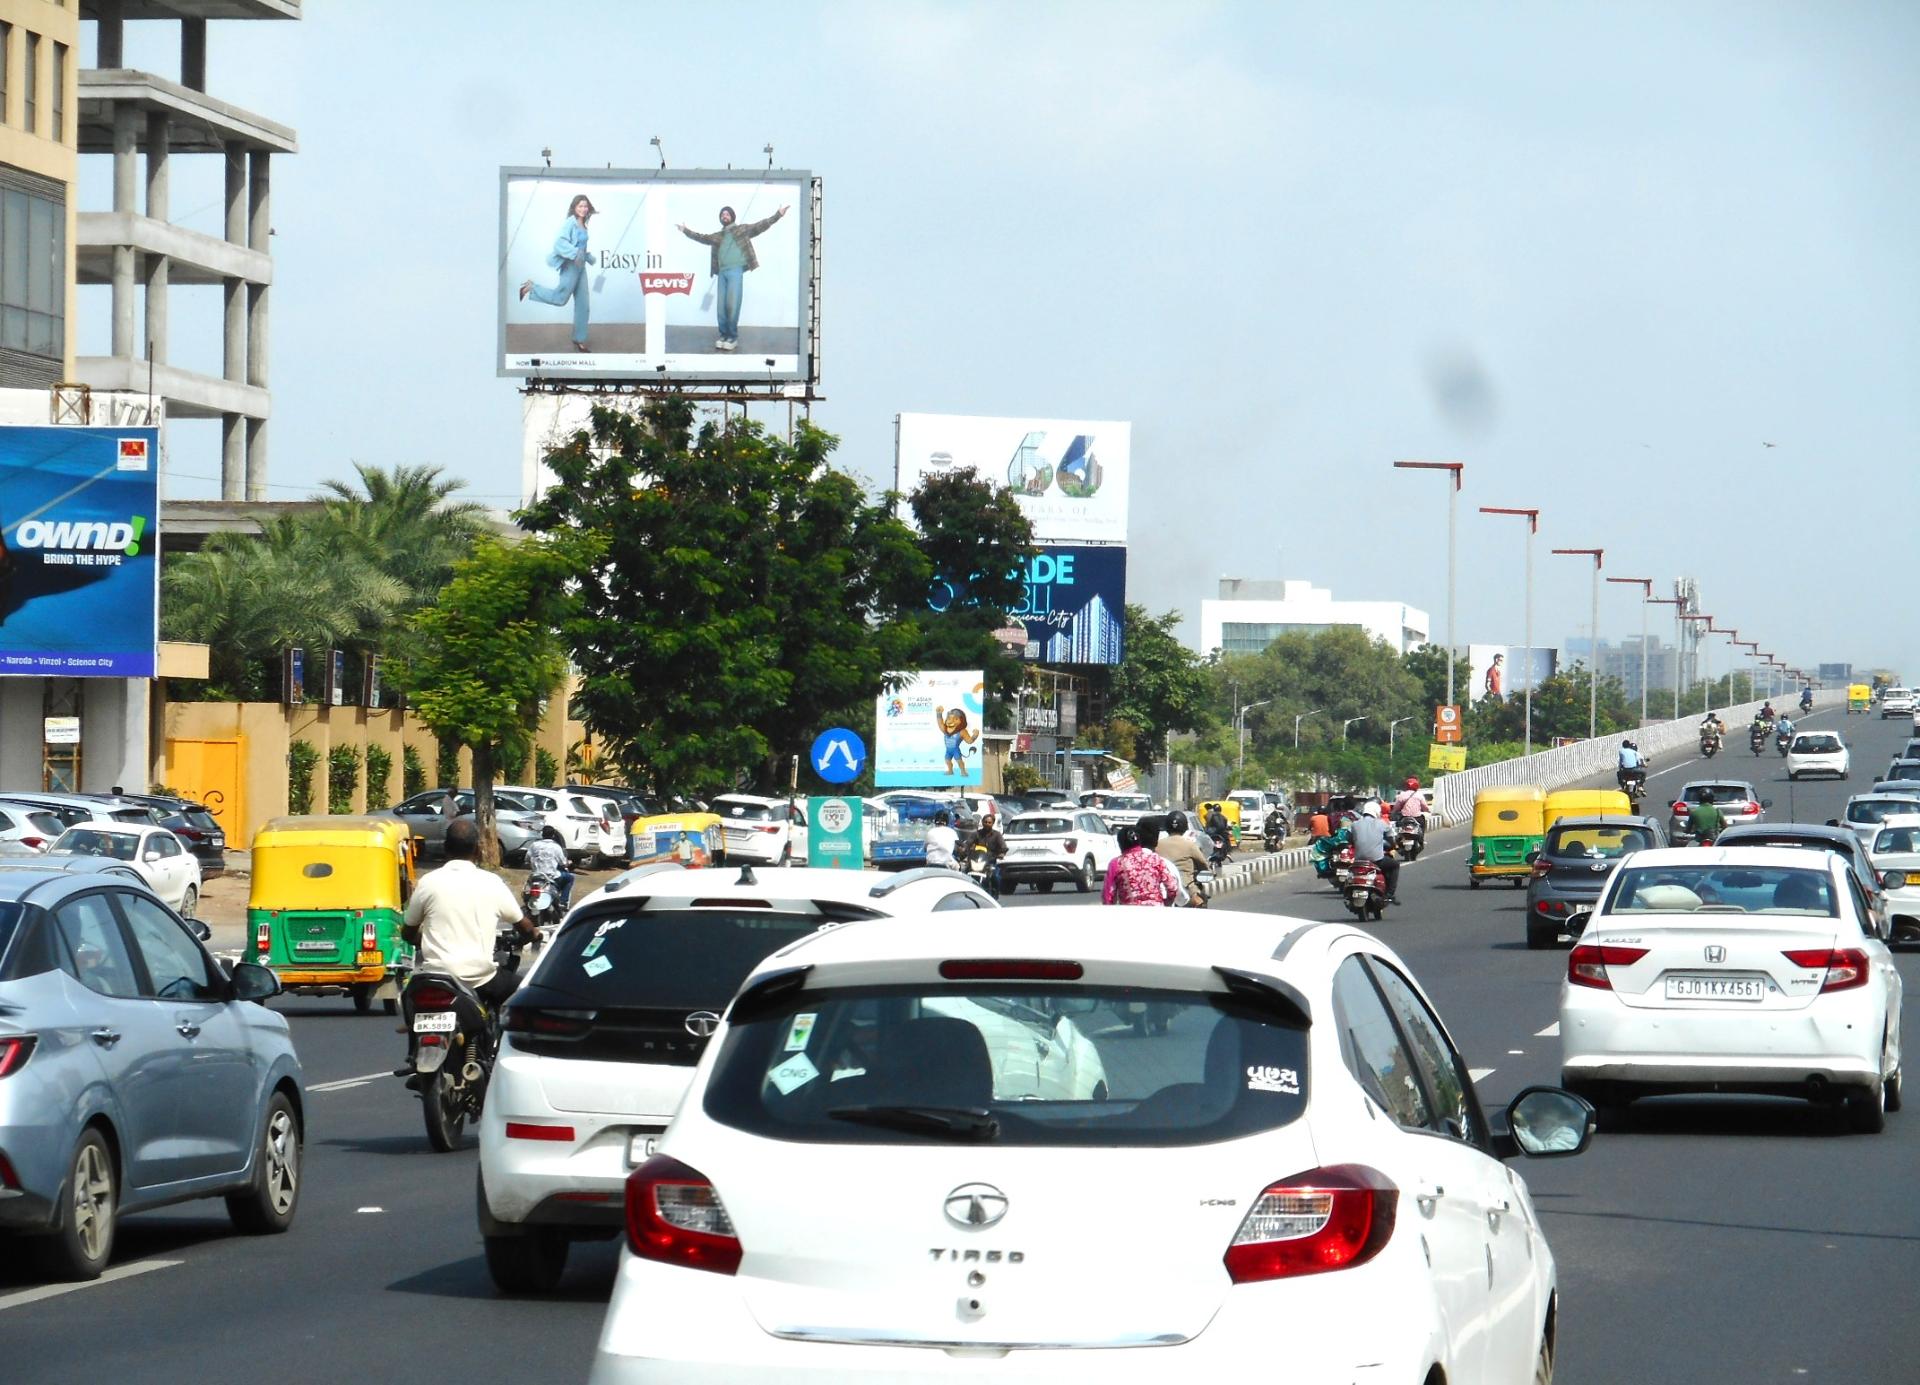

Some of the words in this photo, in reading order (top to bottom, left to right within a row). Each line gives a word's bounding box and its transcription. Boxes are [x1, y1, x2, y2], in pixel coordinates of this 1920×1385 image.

[600, 249, 640, 273] Easy
[646, 250, 662, 269] in
[16, 515, 146, 556] OWND!
[43, 554, 74, 565] BRING
[75, 554, 94, 566] THE
[96, 555, 121, 566] HYPE
[6, 656, 32, 665] Naroda
[67, 658, 97, 667] Science
[98, 658, 114, 668] City
[1677, 980, 1760, 996] GJ01KX4561
[779, 1068, 809, 1078] CNG
[928, 1248, 1025, 1264] TIAGO
